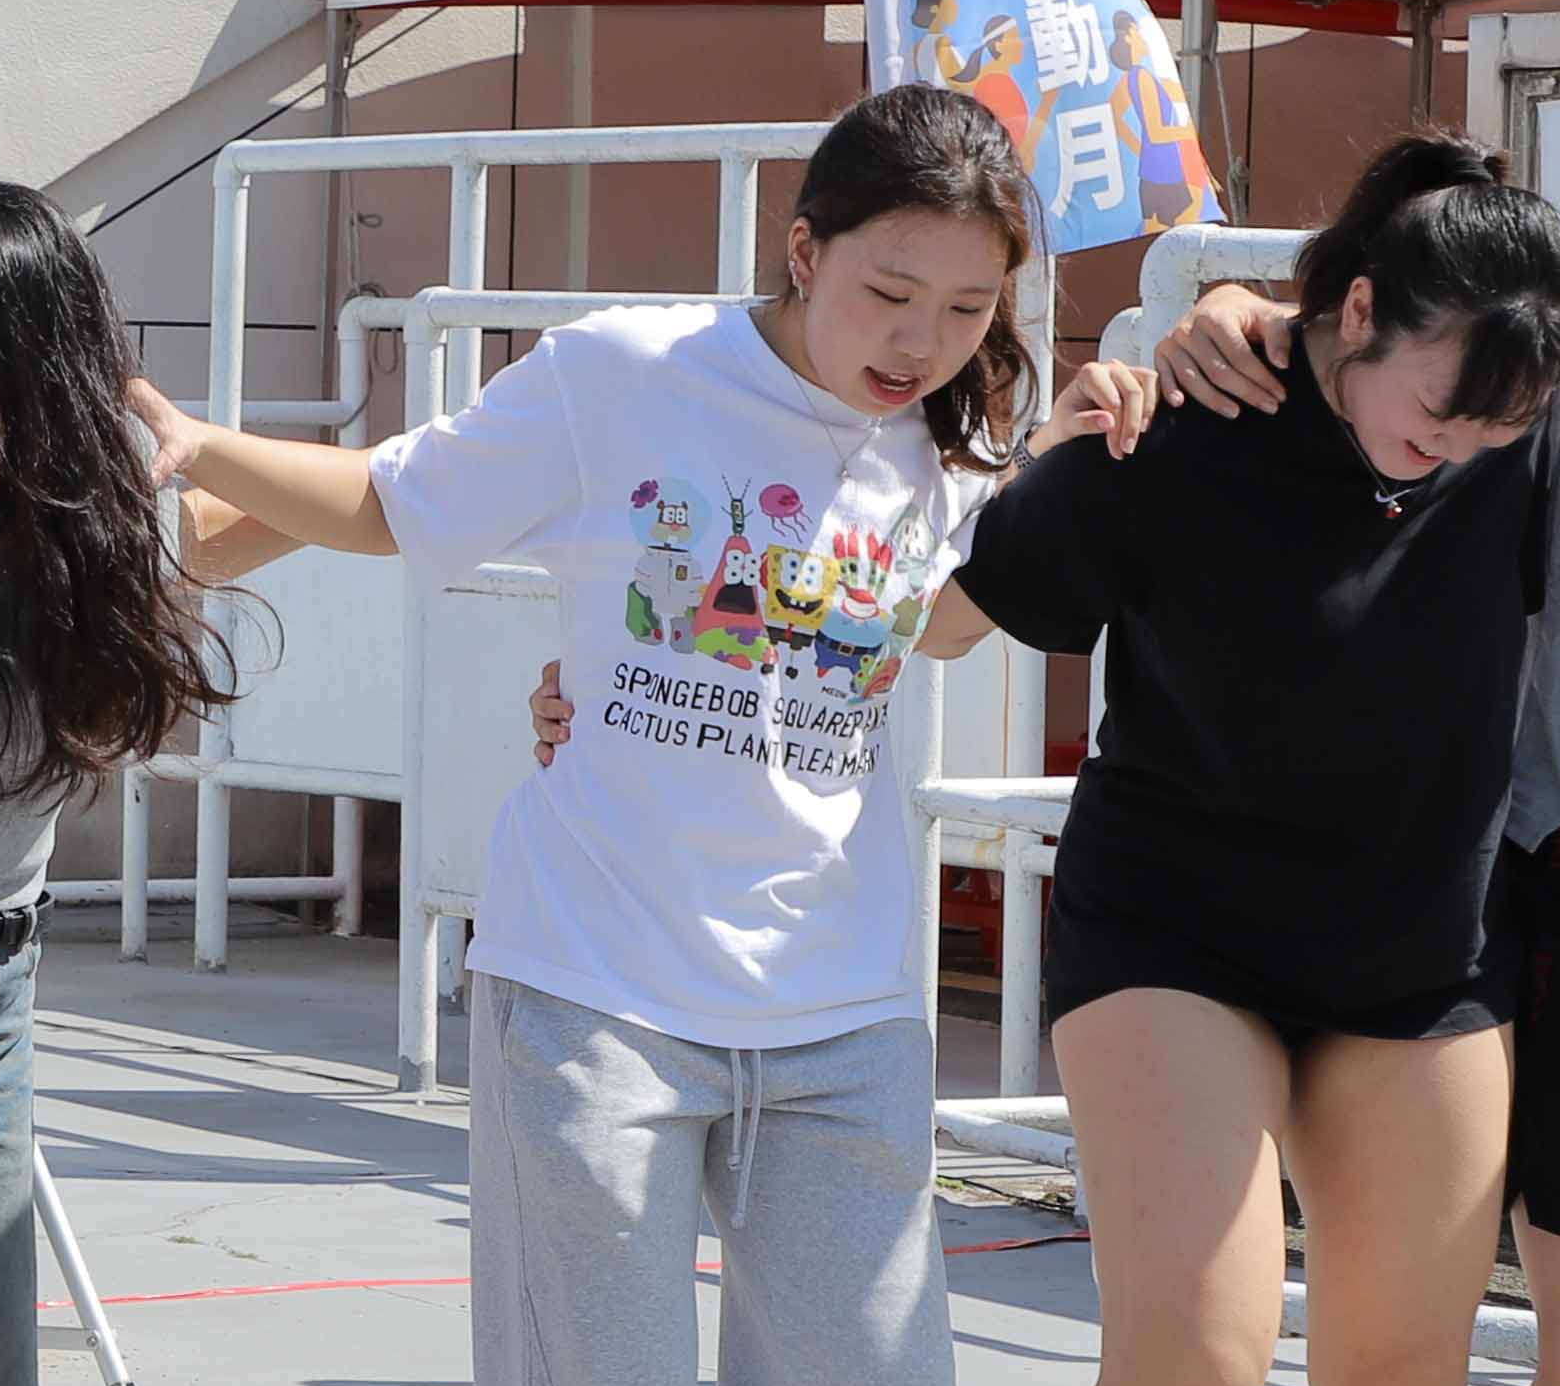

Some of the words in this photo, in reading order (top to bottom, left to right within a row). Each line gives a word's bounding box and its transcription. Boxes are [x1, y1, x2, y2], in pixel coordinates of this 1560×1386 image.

[613, 662, 760, 719] SPONGEBOB
[604, 700, 690, 747] CACTUS
[696, 723, 779, 768] PLANT
[783, 741, 834, 776] FLEA
